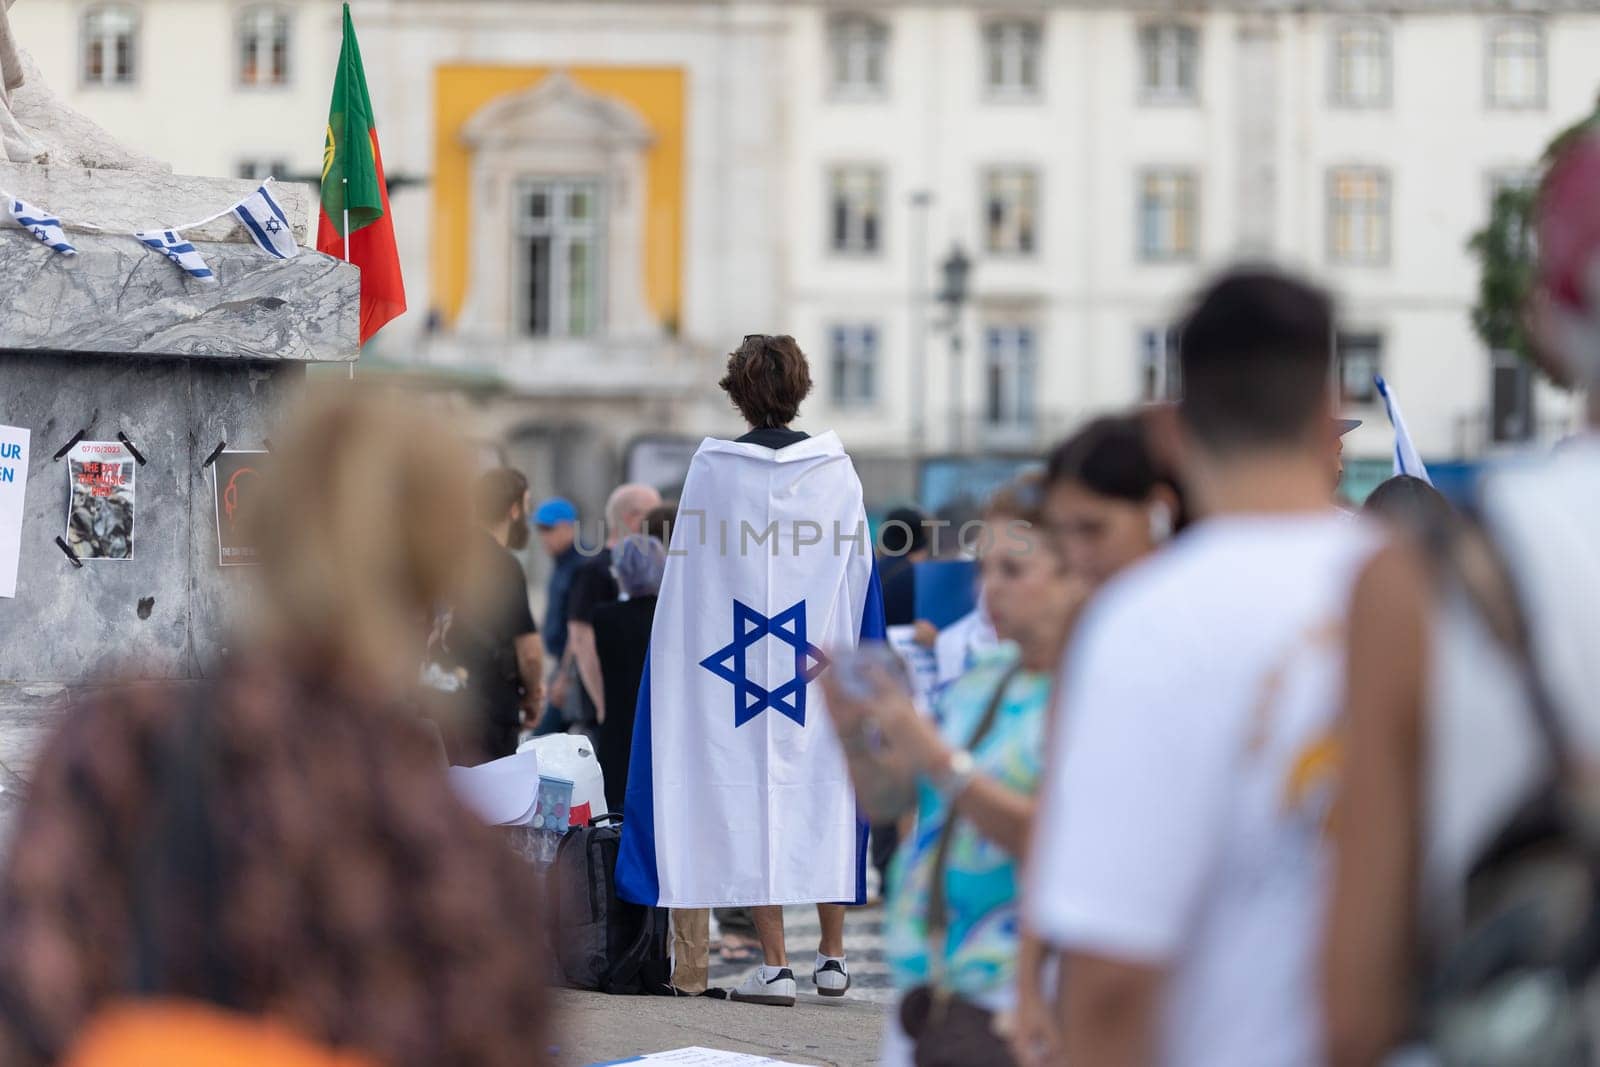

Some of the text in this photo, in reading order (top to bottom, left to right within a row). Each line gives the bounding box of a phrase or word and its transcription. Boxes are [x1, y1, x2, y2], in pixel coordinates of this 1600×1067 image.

[82, 462, 121, 473] THE DAY
[79, 473, 95, 485] THE
